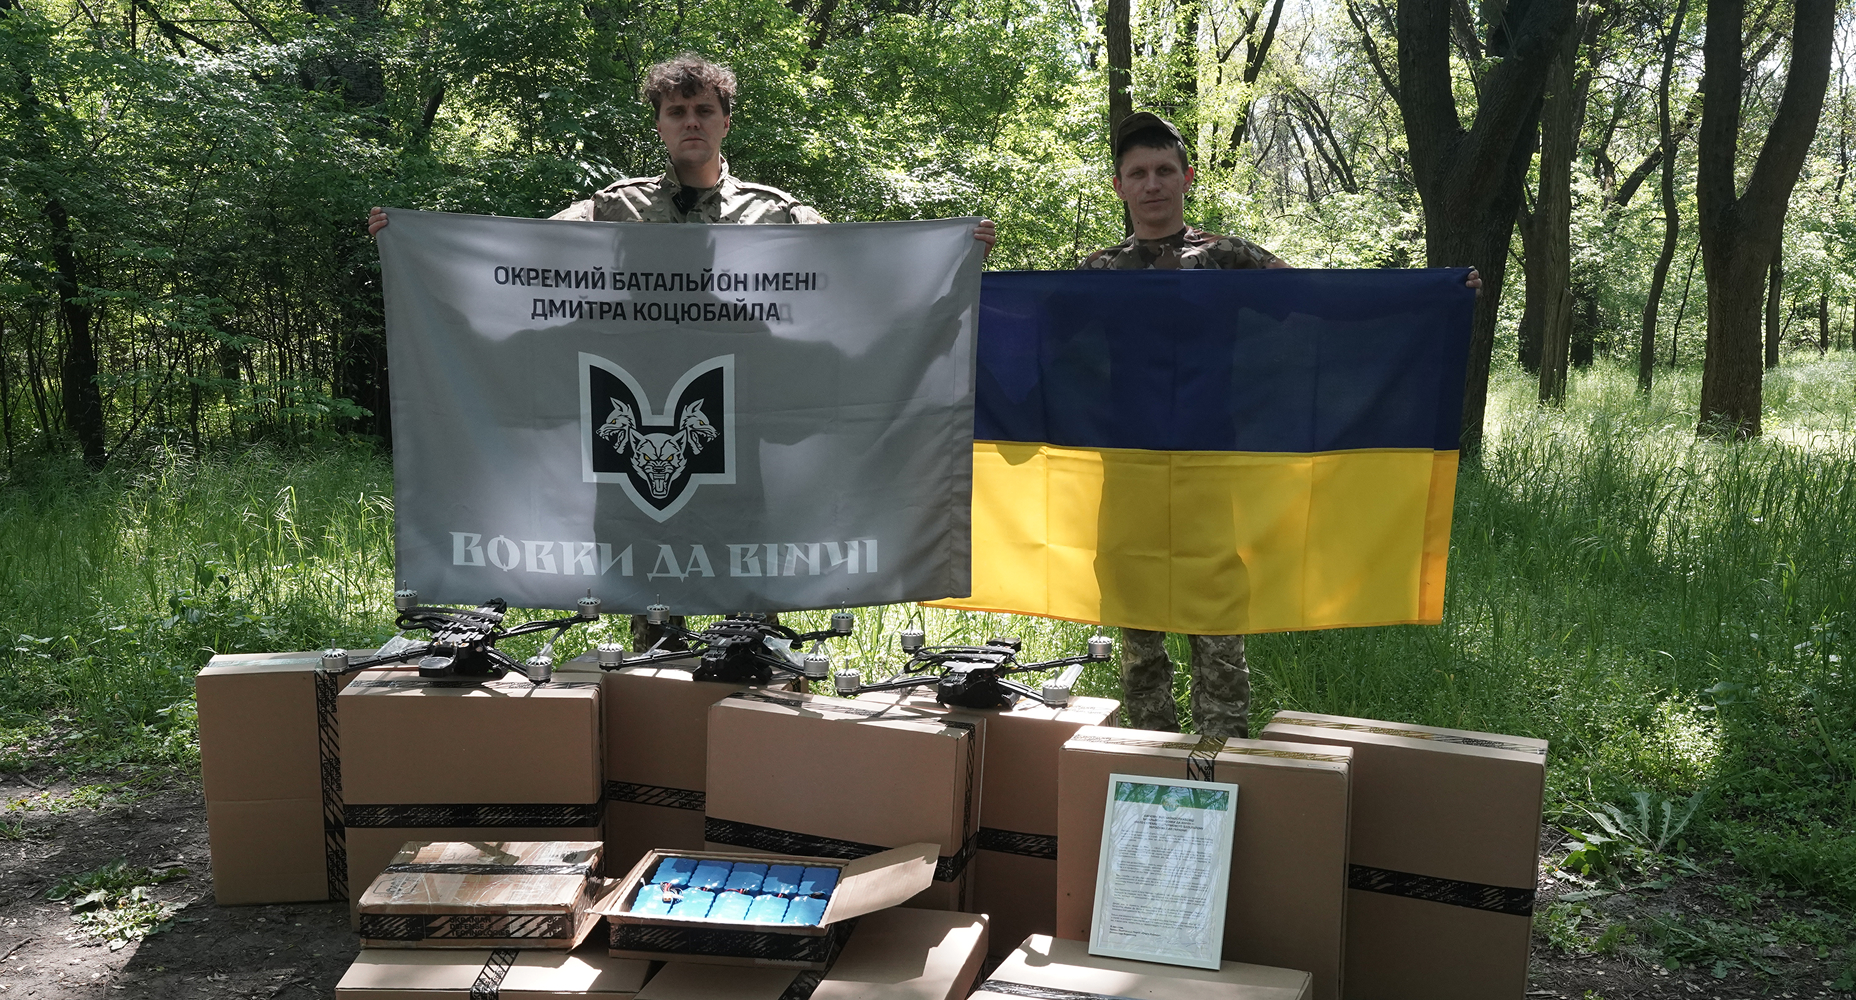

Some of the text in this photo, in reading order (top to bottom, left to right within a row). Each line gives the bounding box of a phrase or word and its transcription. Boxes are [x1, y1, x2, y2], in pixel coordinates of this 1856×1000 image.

[494, 266, 816, 291] ОКРЕМИЙ БАТАЛЬЙОН ІМЕНІ
[531, 298, 780, 324] ДМИТРА КОЦЮБАЙЛА
[449, 531, 633, 577] ВОВКИ
[647, 544, 715, 583] ДА
